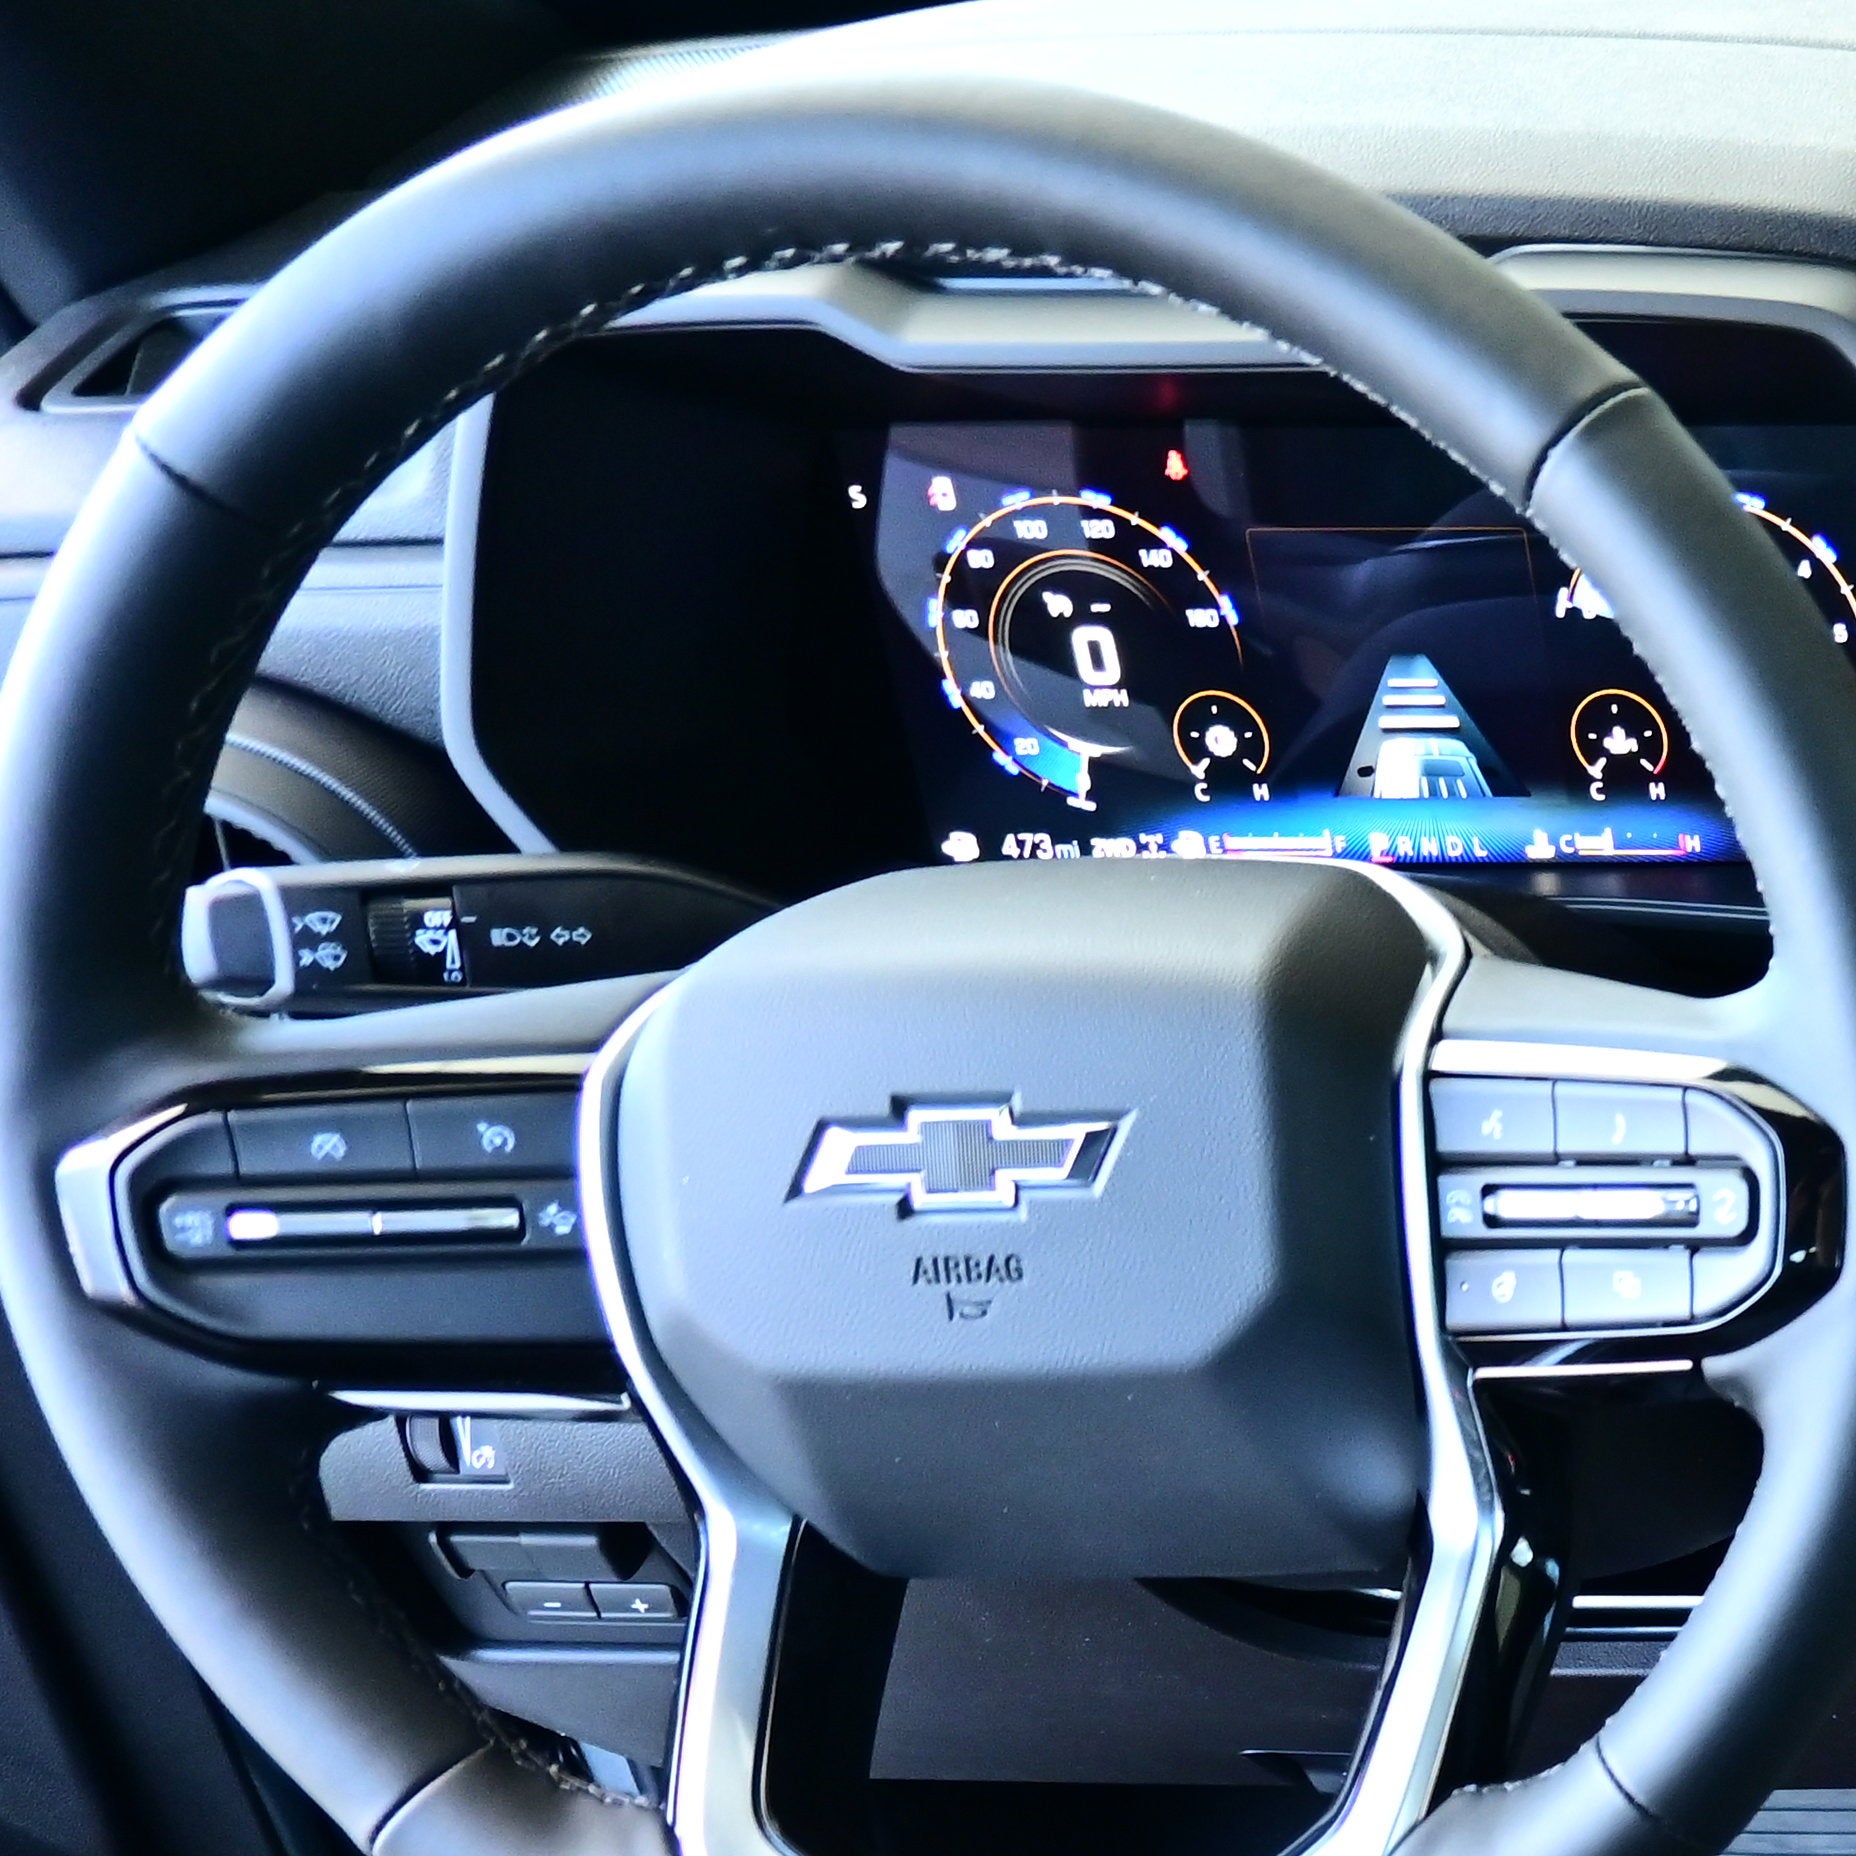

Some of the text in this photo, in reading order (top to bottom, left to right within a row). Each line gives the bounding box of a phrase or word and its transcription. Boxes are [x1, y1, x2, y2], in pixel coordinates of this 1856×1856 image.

[848, 485, 867, 509] S
[1013, 519, 1048, 539] 100
[1080, 519, 1116, 539] 120
[1138, 548, 1173, 568] 140
[1071, 625, 1121, 686] 0
[970, 681, 996, 700] 40
[1082, 688, 1129, 707] MPH
[1014, 738, 1040, 756] 20
[1195, 783, 1209, 802] C
[1254, 783, 1269, 801] H
[1591, 781, 1605, 800] C
[1650, 781, 1666, 799] H
[424, 910, 453, 928] OFF
[911, 1253, 1025, 1286] AIRBAG
